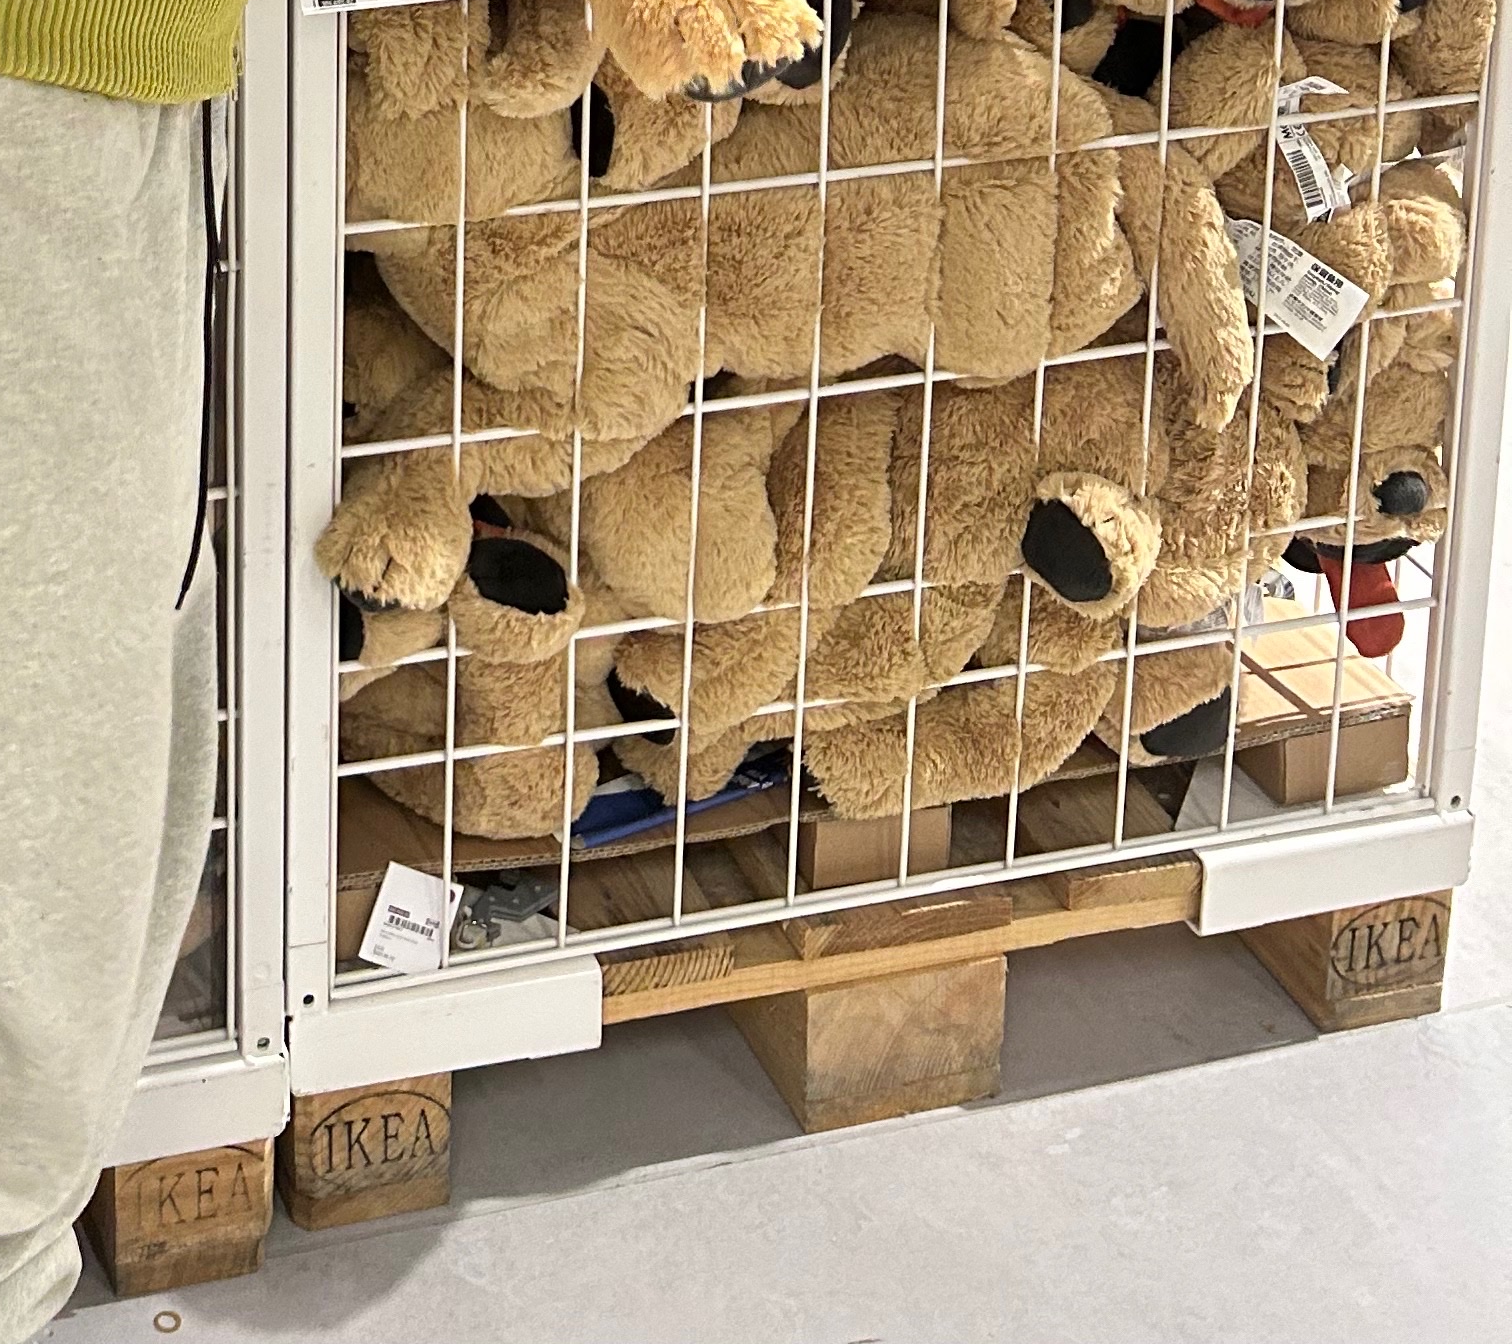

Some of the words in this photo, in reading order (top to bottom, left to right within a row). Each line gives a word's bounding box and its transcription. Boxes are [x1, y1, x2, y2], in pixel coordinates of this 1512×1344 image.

[1345, 913, 1443, 973] IKEA
[324, 1108, 439, 1175] IKEA
[135, 1161, 254, 1232] IKEA
